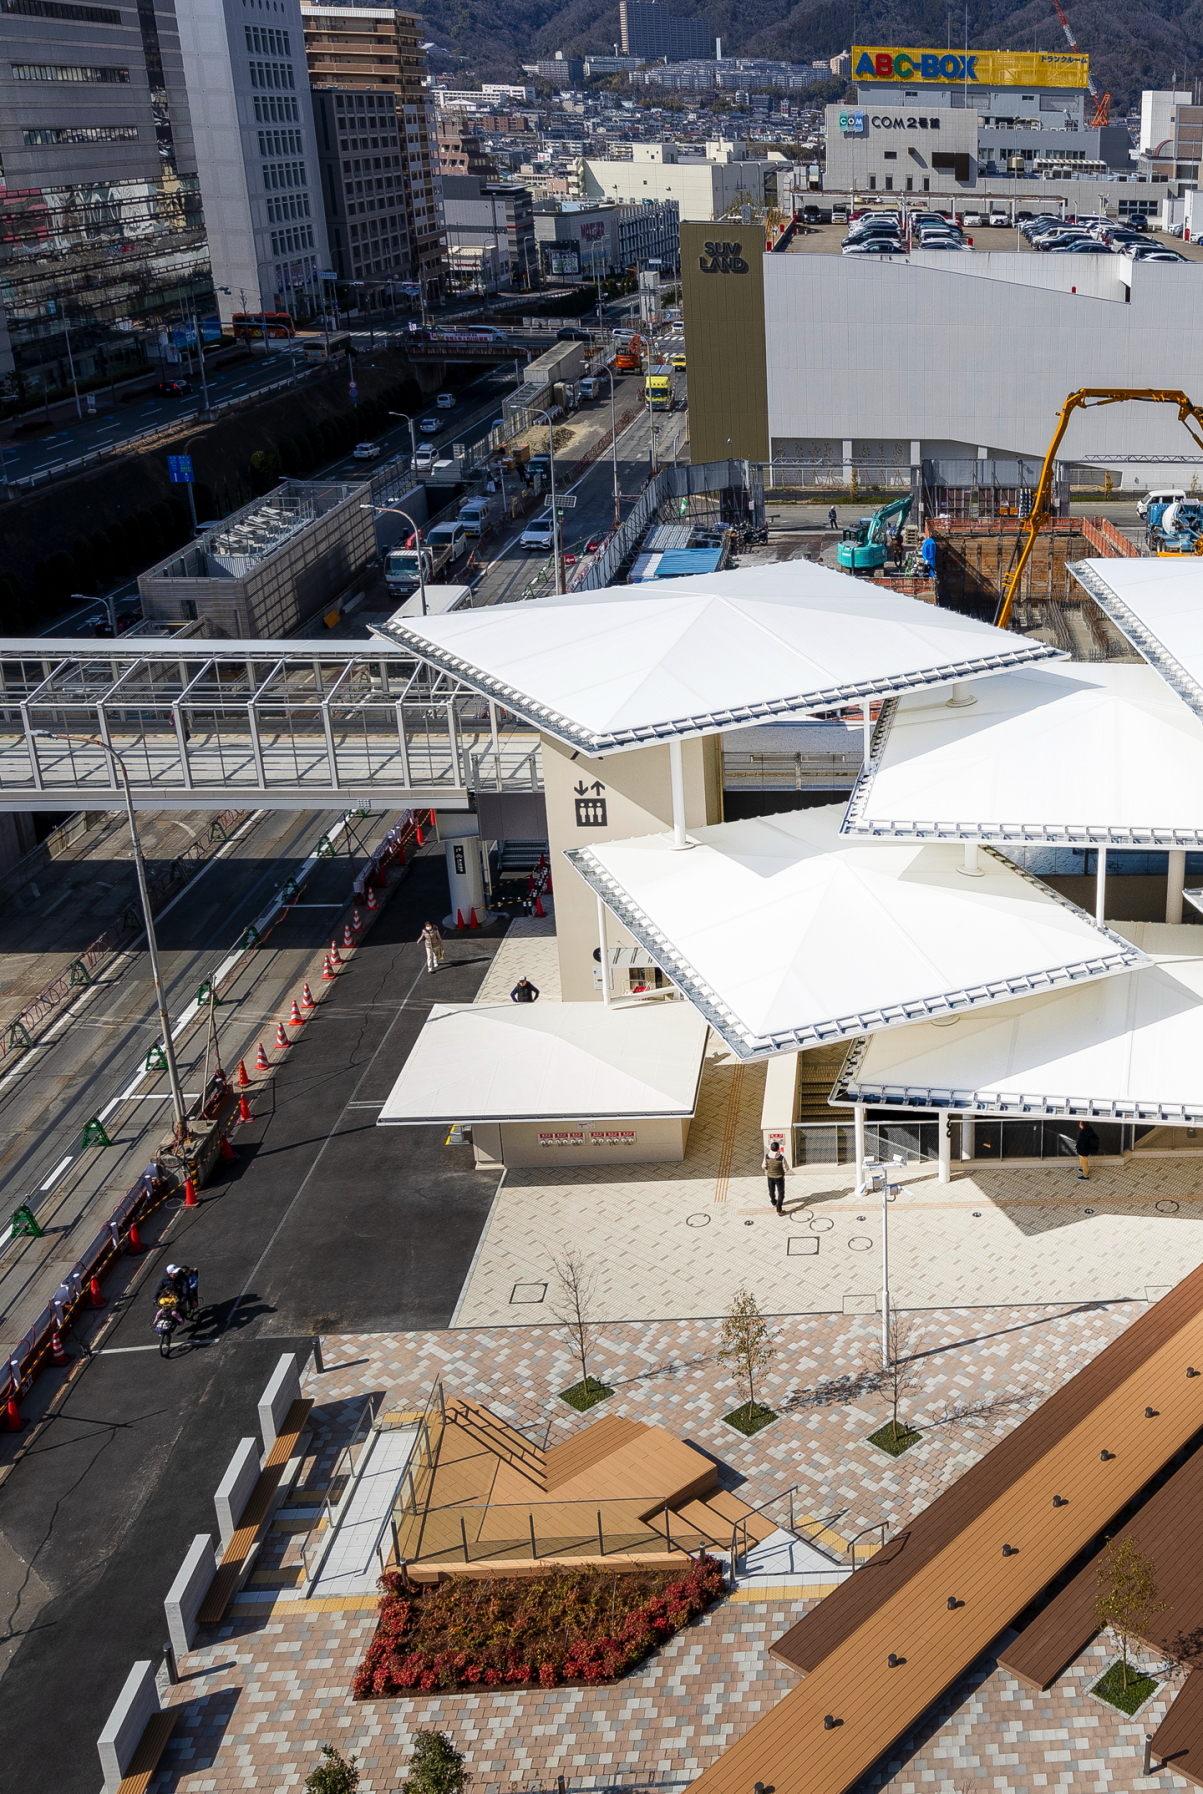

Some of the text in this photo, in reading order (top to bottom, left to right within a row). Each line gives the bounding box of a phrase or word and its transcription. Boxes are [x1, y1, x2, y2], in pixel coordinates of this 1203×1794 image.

[855, 52, 978, 79] ABC-BOX
[1041, 55, 1088, 64] トランクルーム
[840, 117, 863, 125] COM
[703, 241, 741, 256] SUV
[699, 255, 747, 272] LAND
